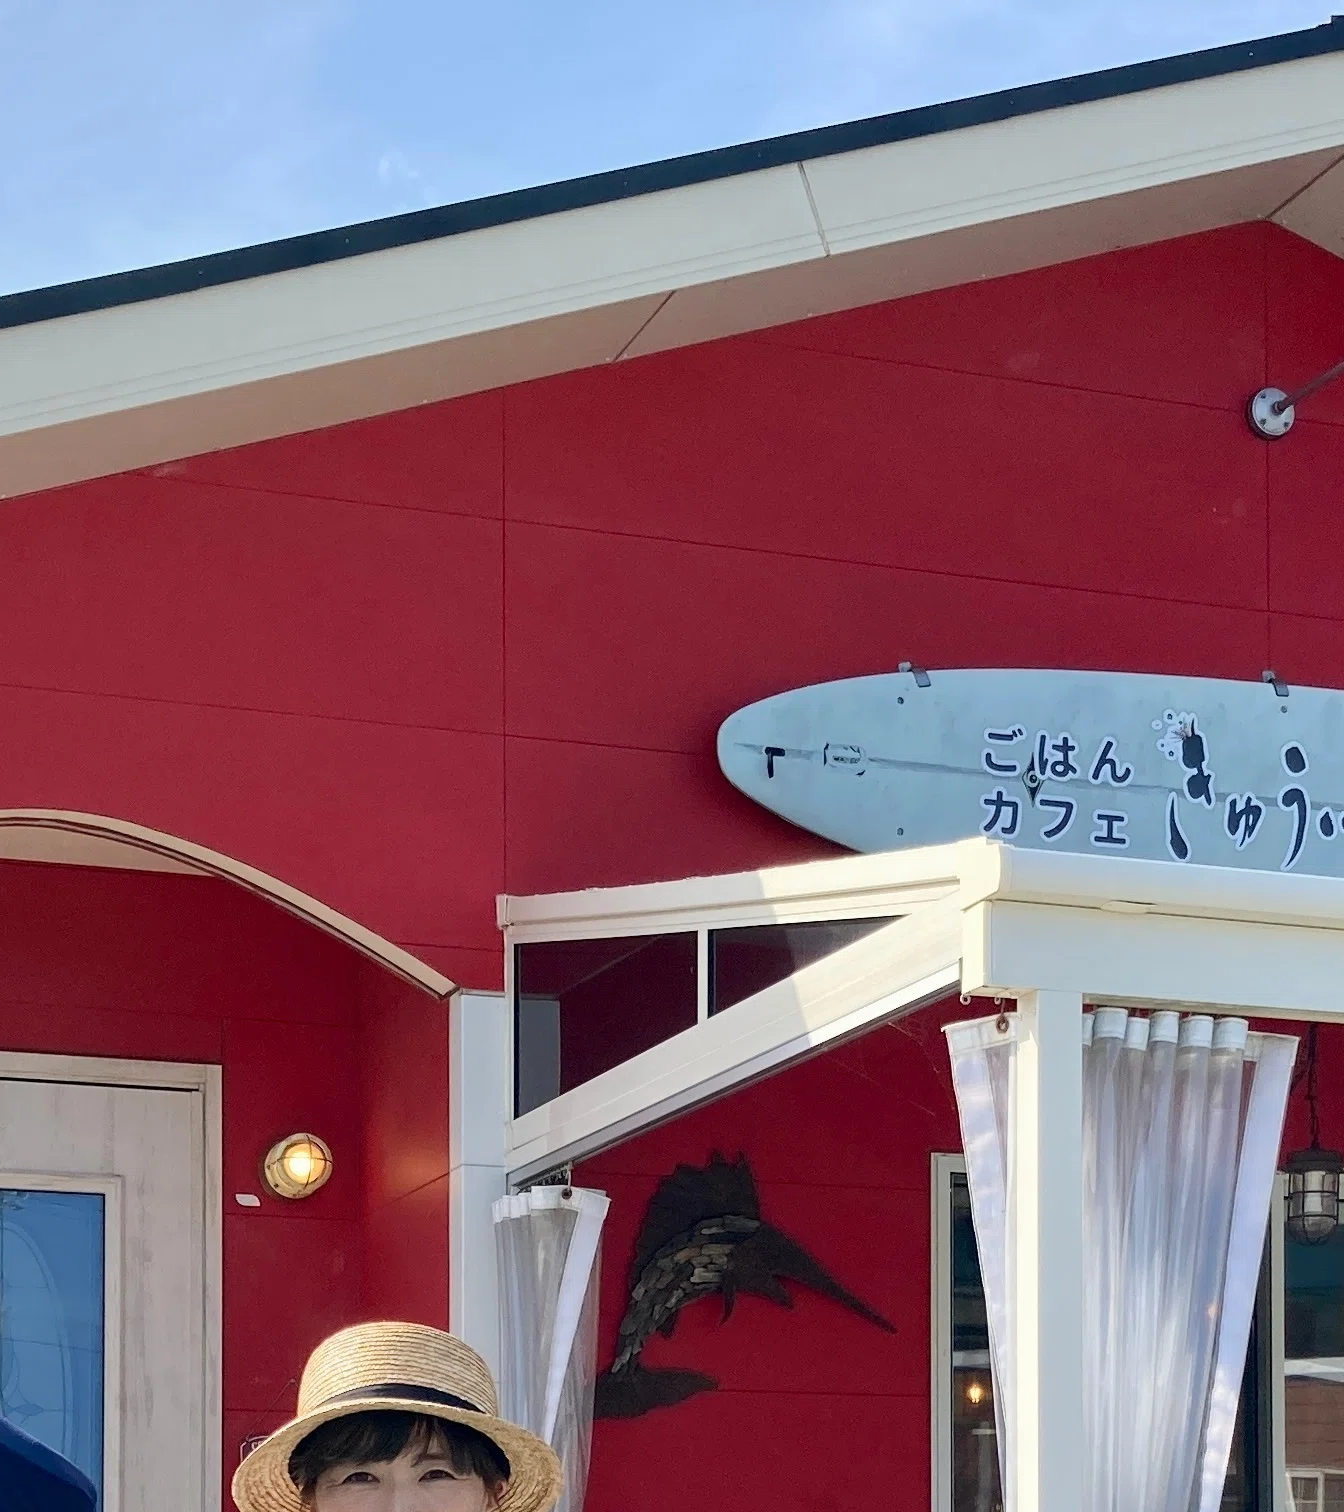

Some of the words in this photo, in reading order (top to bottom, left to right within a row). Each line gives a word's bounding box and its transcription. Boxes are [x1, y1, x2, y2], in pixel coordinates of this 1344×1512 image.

[985, 727, 1132, 784] ごはん
[982, 790, 1128, 845] カフェ
